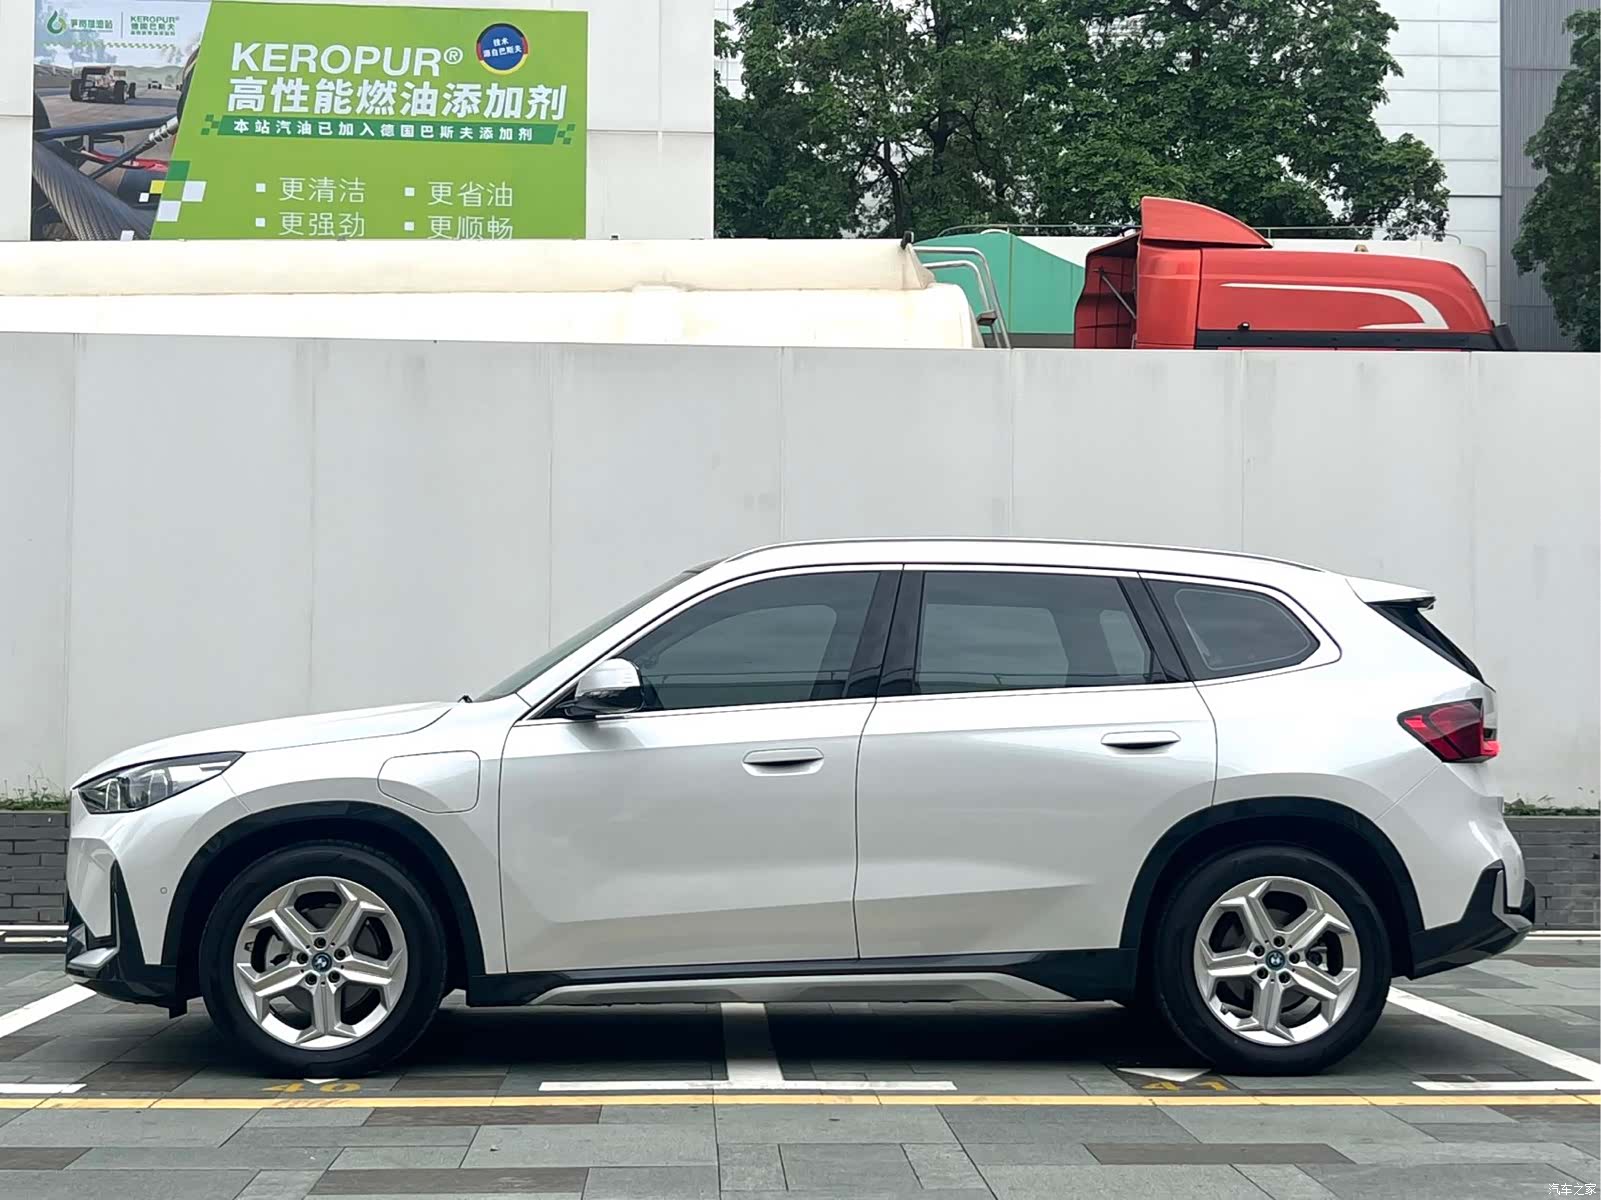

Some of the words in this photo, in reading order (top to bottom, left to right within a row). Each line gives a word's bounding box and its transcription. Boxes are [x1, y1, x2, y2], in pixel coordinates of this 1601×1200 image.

[227, 75, 568, 121] 高性能燃油添加剂
[233, 118, 533, 142] 本站汽油已加入德国巴斯夫添加剂
[279, 176, 367, 203] 更清洁
[427, 181, 513, 207] 更省油
[278, 211, 366, 238] 更强劲
[427, 215, 514, 241] 更顺畅
